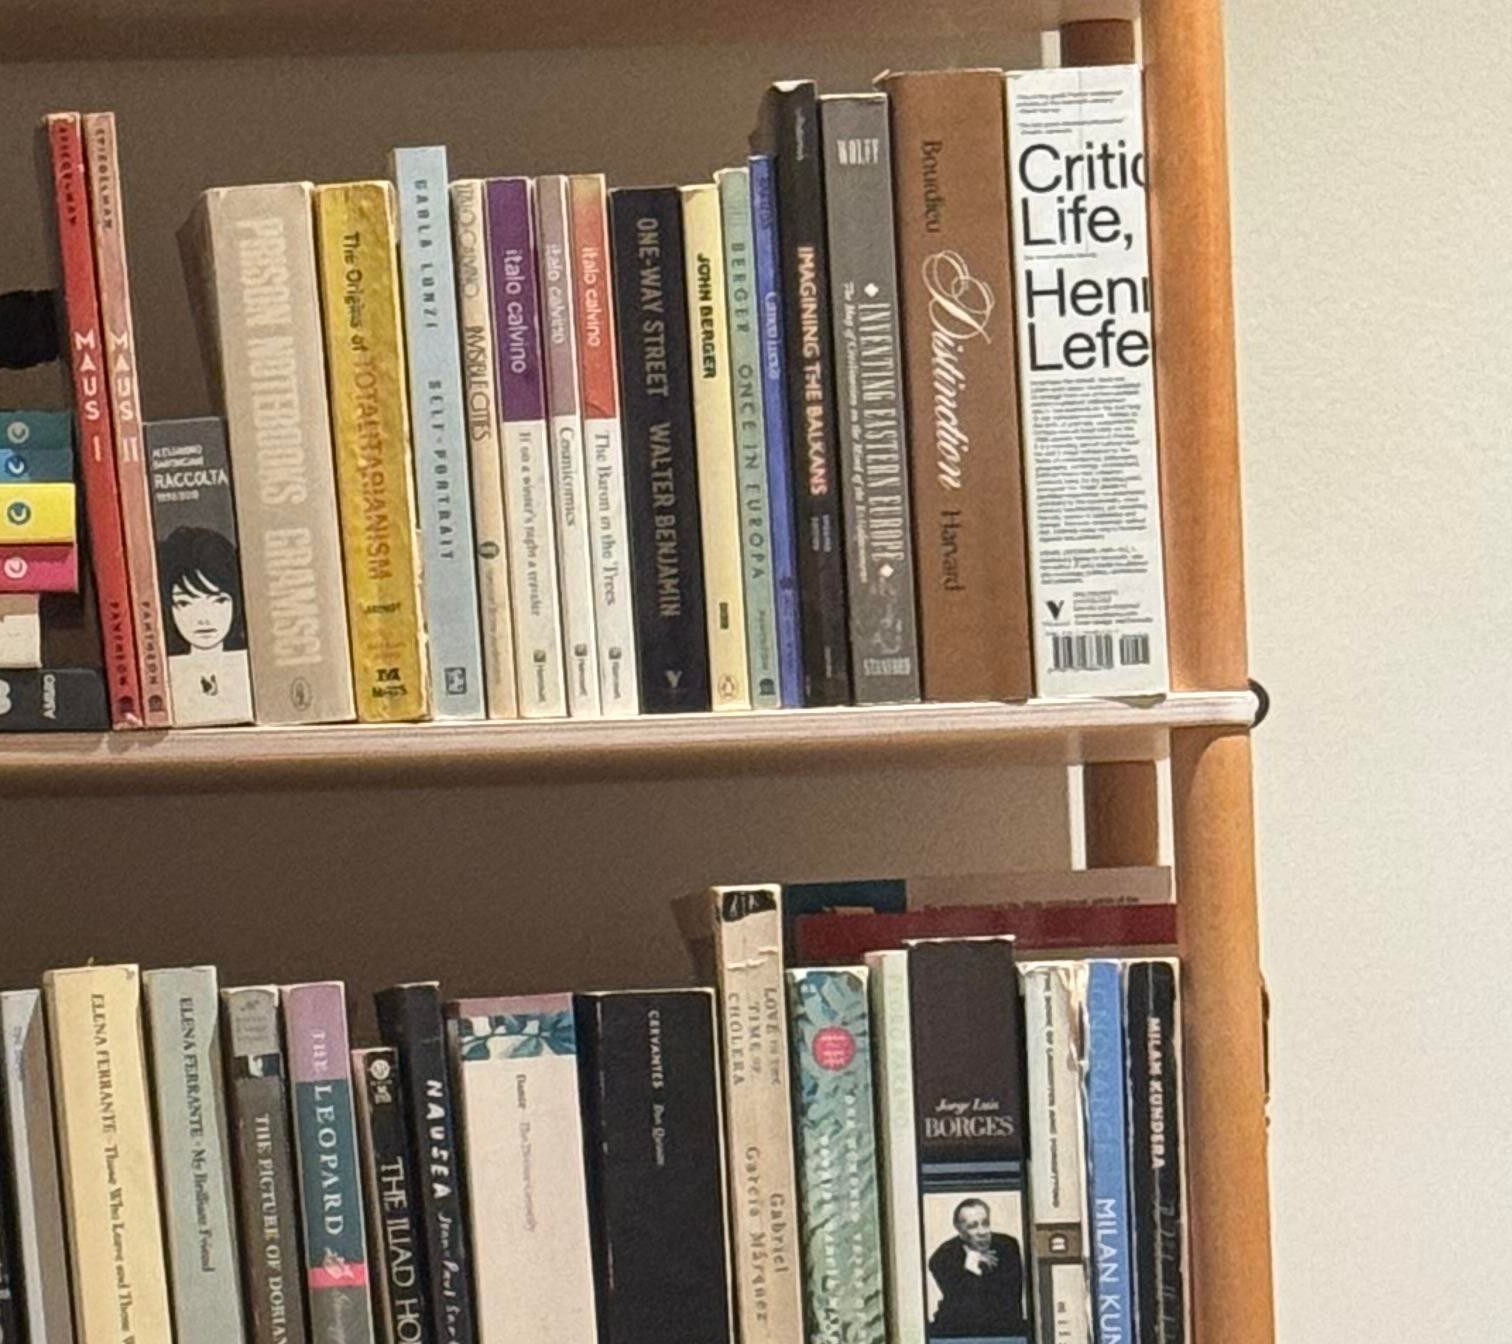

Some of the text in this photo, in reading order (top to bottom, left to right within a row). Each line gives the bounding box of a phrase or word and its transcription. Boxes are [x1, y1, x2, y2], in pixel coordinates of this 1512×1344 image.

[1023, 198, 1133, 249] Life,
[505, 250, 529, 373] italo calvino
[636, 217, 668, 396] ONE-WAY STREET
[695, 253, 716, 379] JOHN BERGER
[73, 330, 101, 422] MAUS
[110, 329, 139, 422] MAUS
[797, 246, 828, 495] IMAGINING THE BALKANS
[923, 253, 994, 490] Distinction
[239, 218, 322, 666] PRISON NOTEBOOKS GRAMSCI
[353, 357, 391, 580] TOTALITARIANISM
[858, 303, 904, 560] INVENTING EASTERN EUROPE
[154, 470, 228, 488] RACCOLTA
[649, 424, 680, 617] WALTER BENJAMIN
[647, 1010, 665, 1088] CERVANTES
[254, 1114, 272, 1153] THE
[313, 1086, 345, 1236] LEOPARD
[426, 1081, 450, 1198] NAUSEA
[923, 1118, 1014, 1137] BORGES
[257, 1160, 279, 1240] PICTURE
[380, 1157, 407, 1209] THE
[265, 1245, 282, 1271] OF
[387, 1219, 414, 1286] ILIAD
[1095, 1199, 1120, 1284] MILAN
